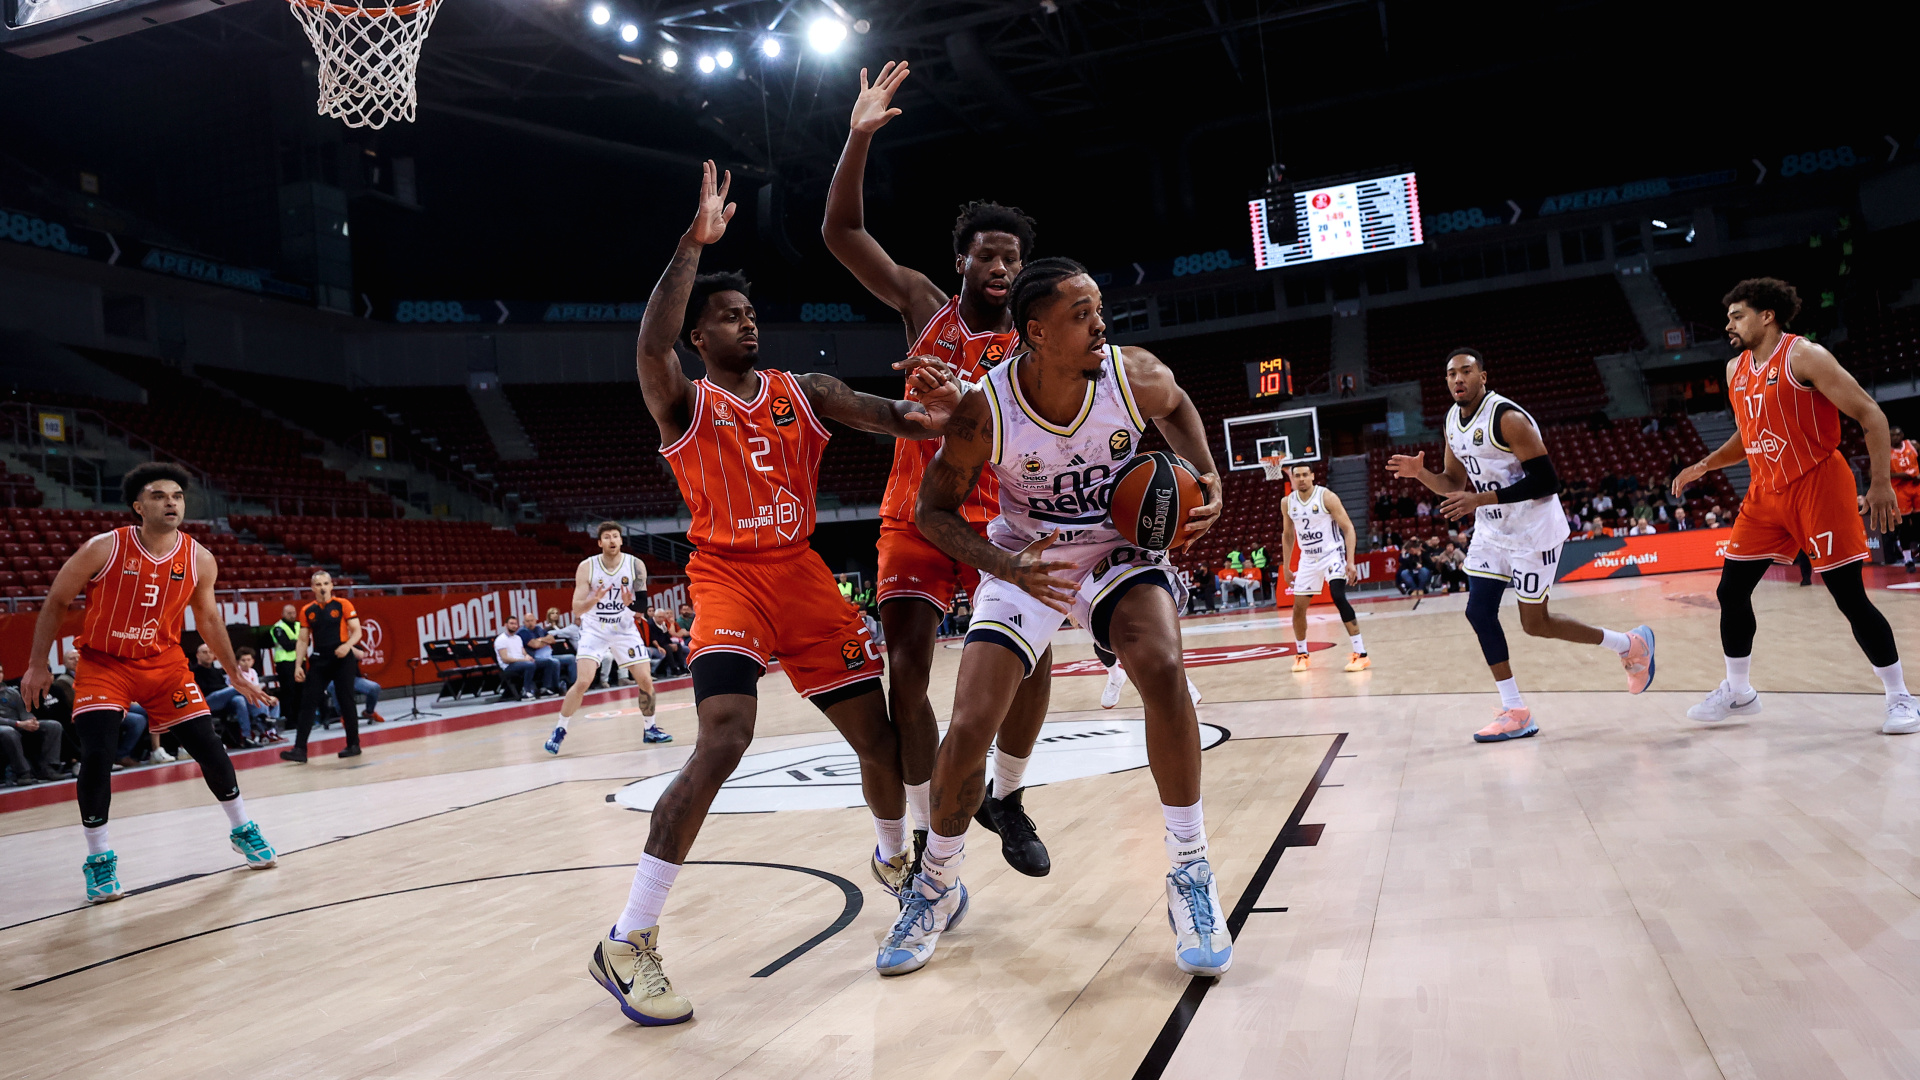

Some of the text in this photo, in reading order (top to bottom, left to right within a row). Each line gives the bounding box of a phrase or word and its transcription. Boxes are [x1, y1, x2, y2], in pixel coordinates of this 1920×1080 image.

[1260, 358, 1281, 373] 1:49
[1261, 373, 1280, 393] 10
[1745, 393, 1763, 419] 17
[748, 436, 774, 471] 2
[775, 502, 798, 525] IBI
[1147, 487, 1173, 549] PALDING
[1302, 518, 1310, 530] 2
[1809, 531, 1833, 558] 17
[1333, 562, 1342, 573] 2
[1512, 568, 1539, 594] 50
[140, 584, 160, 607] 3
[714, 628, 746, 639] nuvei
[185, 682, 203, 704] 3
